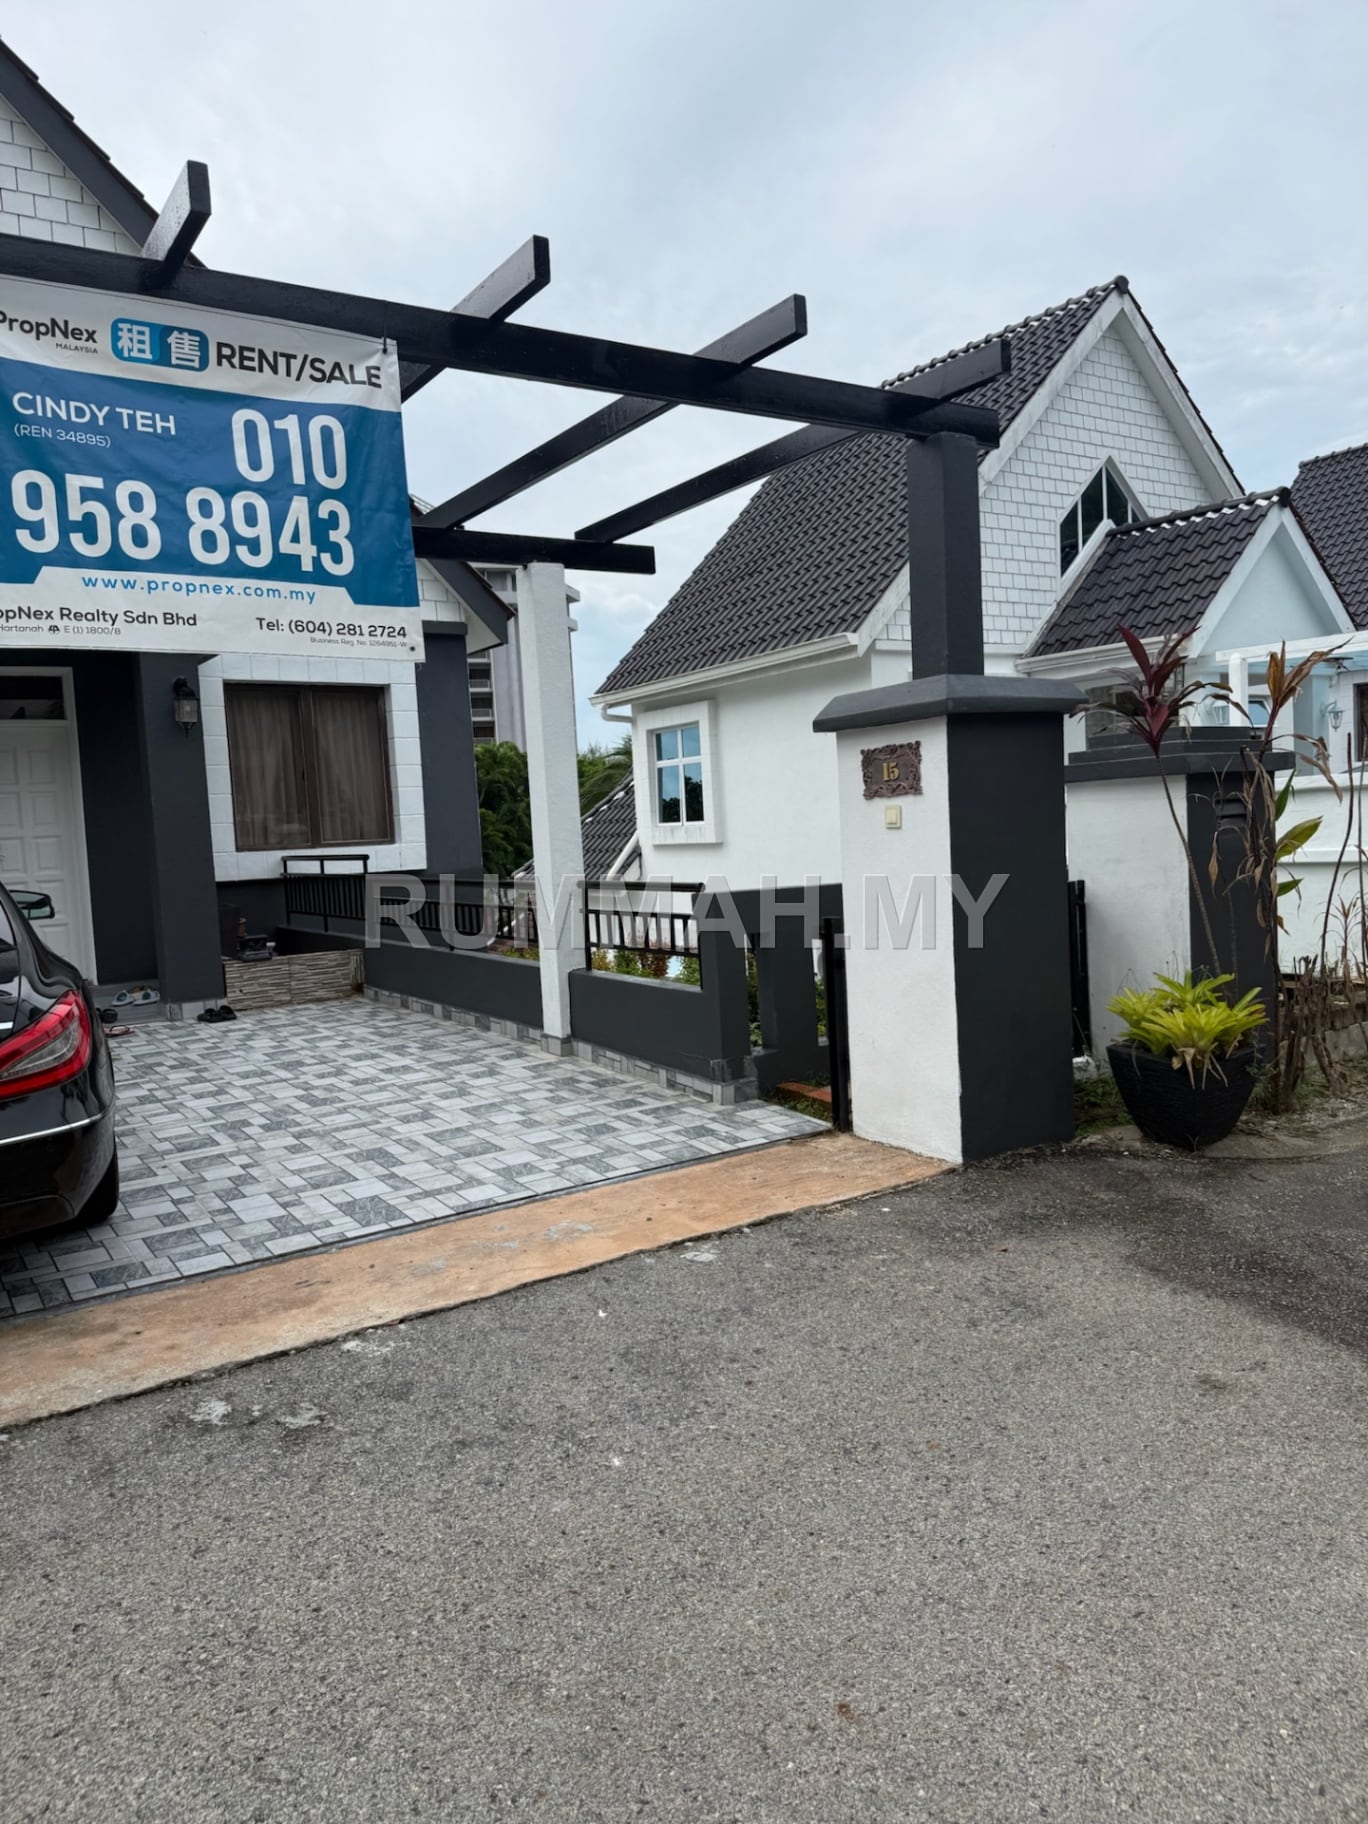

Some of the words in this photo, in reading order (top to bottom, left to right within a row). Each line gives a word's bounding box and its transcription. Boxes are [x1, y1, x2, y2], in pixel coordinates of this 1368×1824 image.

[55, 342, 98, 354] MALAYSIA
[216, 341, 382, 388] RENT/SALE
[12, 392, 110, 426] CINDY
[115, 407, 176, 435] TEH
[14, 423, 53, 438] (REN
[56, 429, 111, 448] 34895)
[231, 408, 347, 490] 010
[11, 469, 162, 561] 958
[185, 486, 355, 576] 8943
[82, 575, 316, 605] www.propnex.com.my
[59, 607, 119, 626] Realty
[123, 610, 158, 625] Sdn
[162, 612, 197, 626] Bhd
[256, 617, 285, 632] Tel:
[288, 619, 333, 637] (604)
[336, 622, 365, 637] 281
[368, 624, 407, 639] 2724
